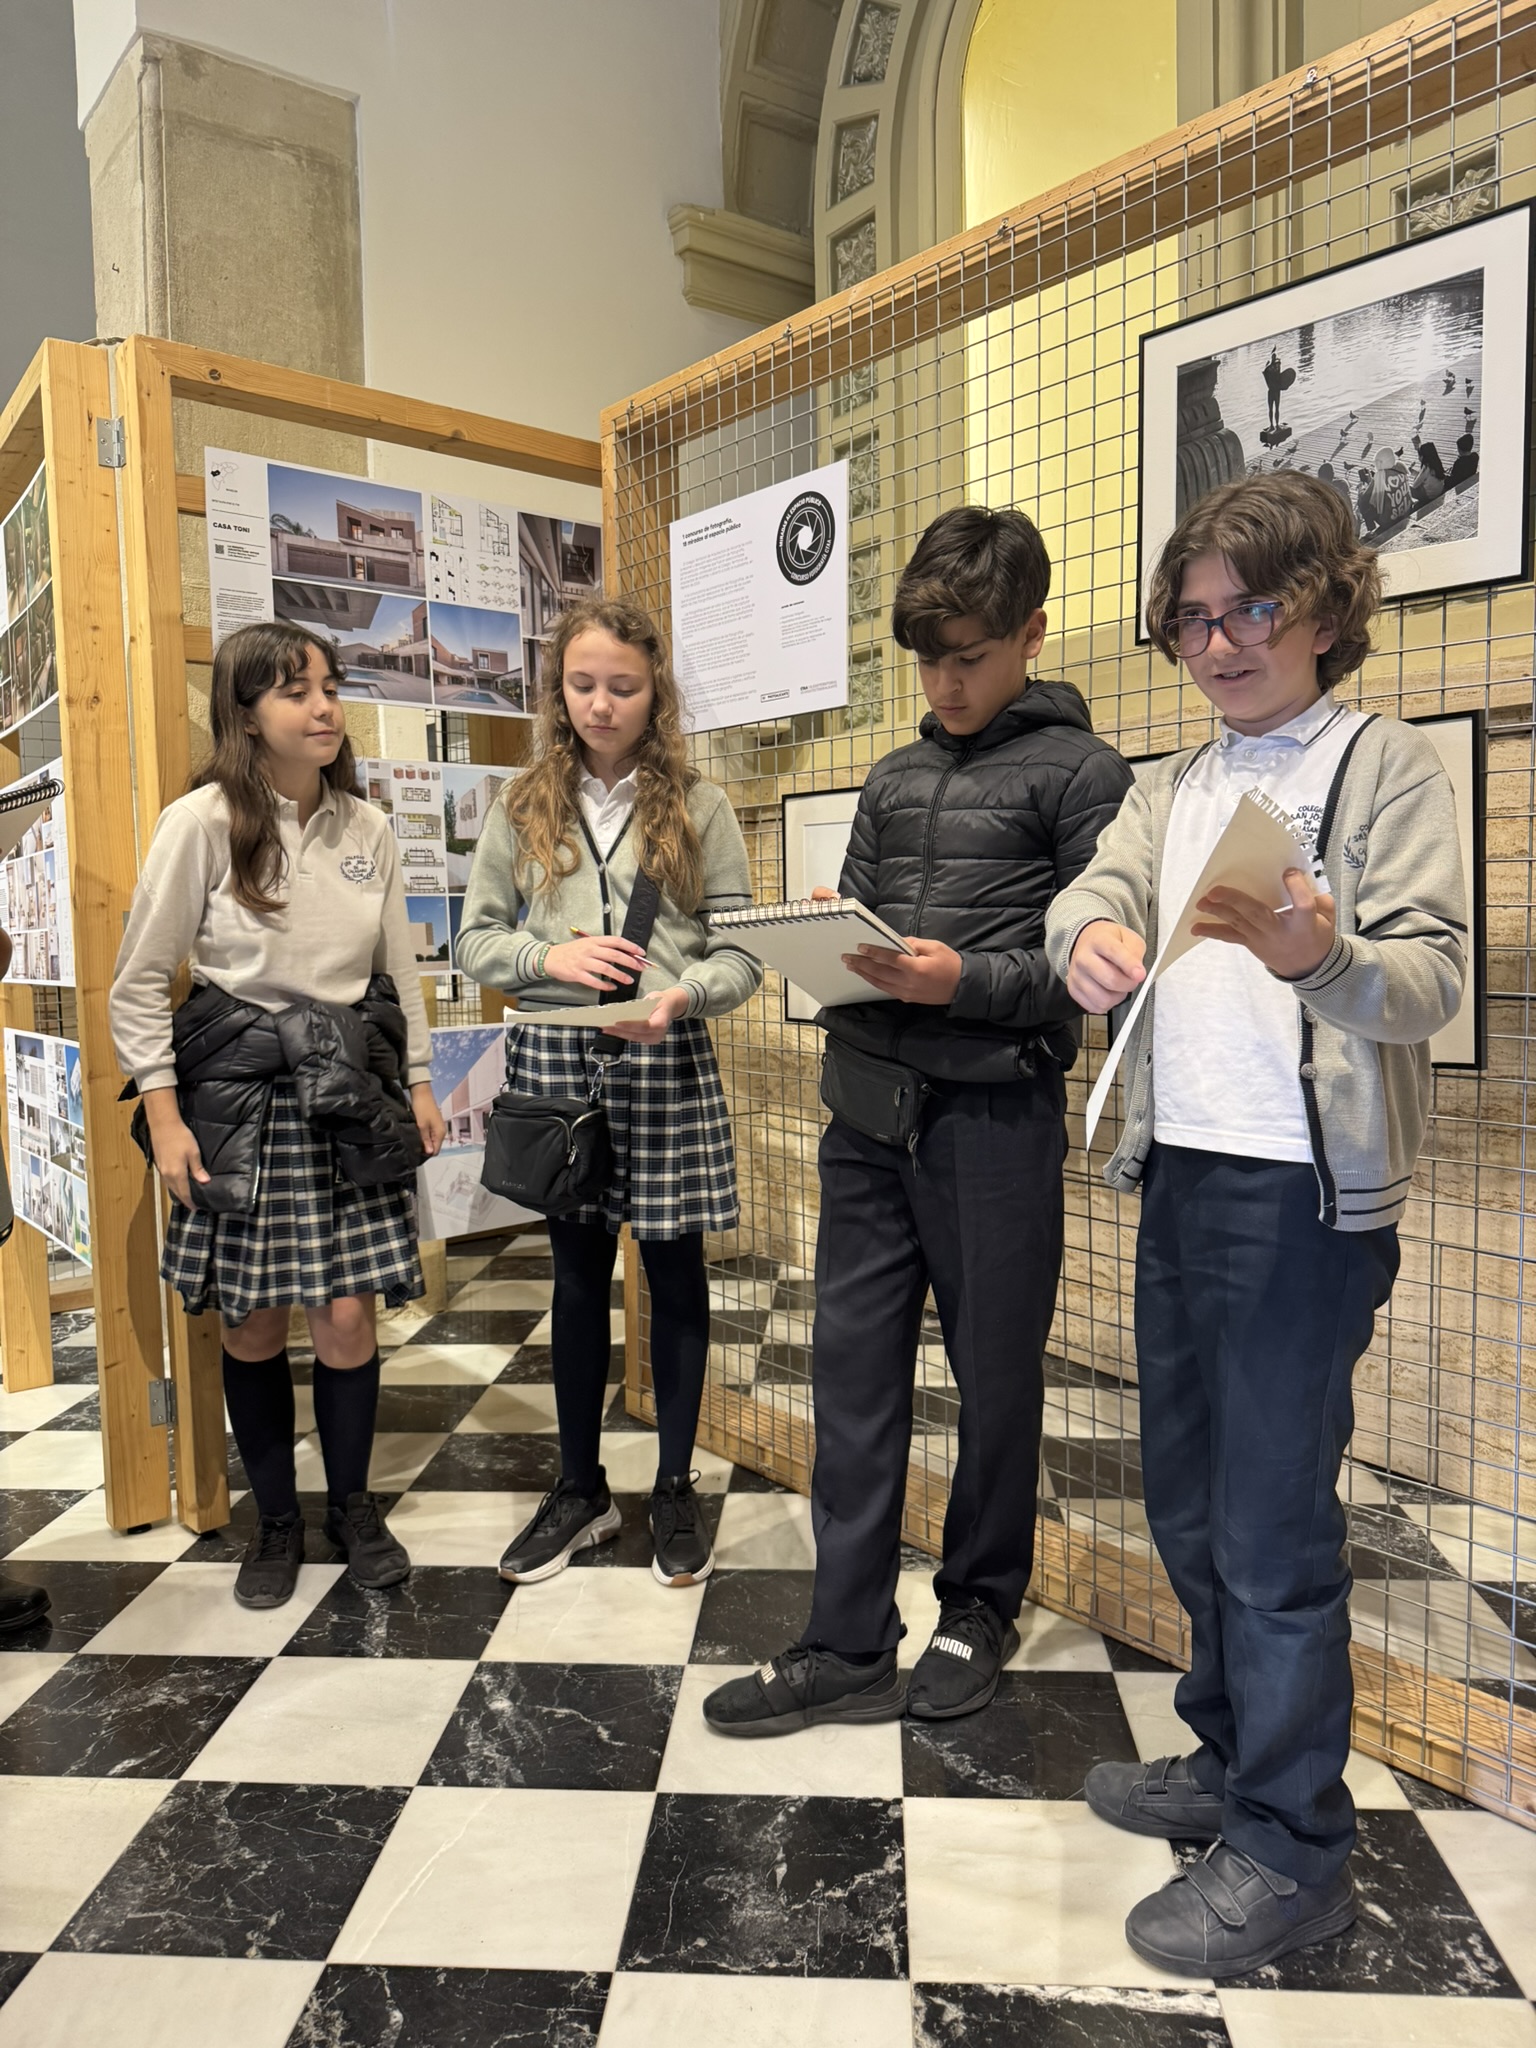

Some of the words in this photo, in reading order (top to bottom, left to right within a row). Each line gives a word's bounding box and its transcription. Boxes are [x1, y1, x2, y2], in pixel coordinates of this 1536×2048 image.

[213, 522, 232, 531] CASA
[233, 525, 250, 533] TONI
[779, 521, 788, 548] MIRADAS
[789, 498, 806, 514] ESPACIO
[805, 495, 822, 507] PÚBLICO
[685, 528, 703, 539] concurso
[687, 535, 703, 545] miradas
[709, 528, 725, 538] espacio
[725, 523, 741, 534] público
[790, 571, 809, 581] CONCURSO
[809, 553, 827, 578] FOTOGRAFÍA
[1290, 812, 1307, 820] SAN
[1298, 805, 1324, 813] COLEGI
[931, 1635, 973, 1661] PUMA
